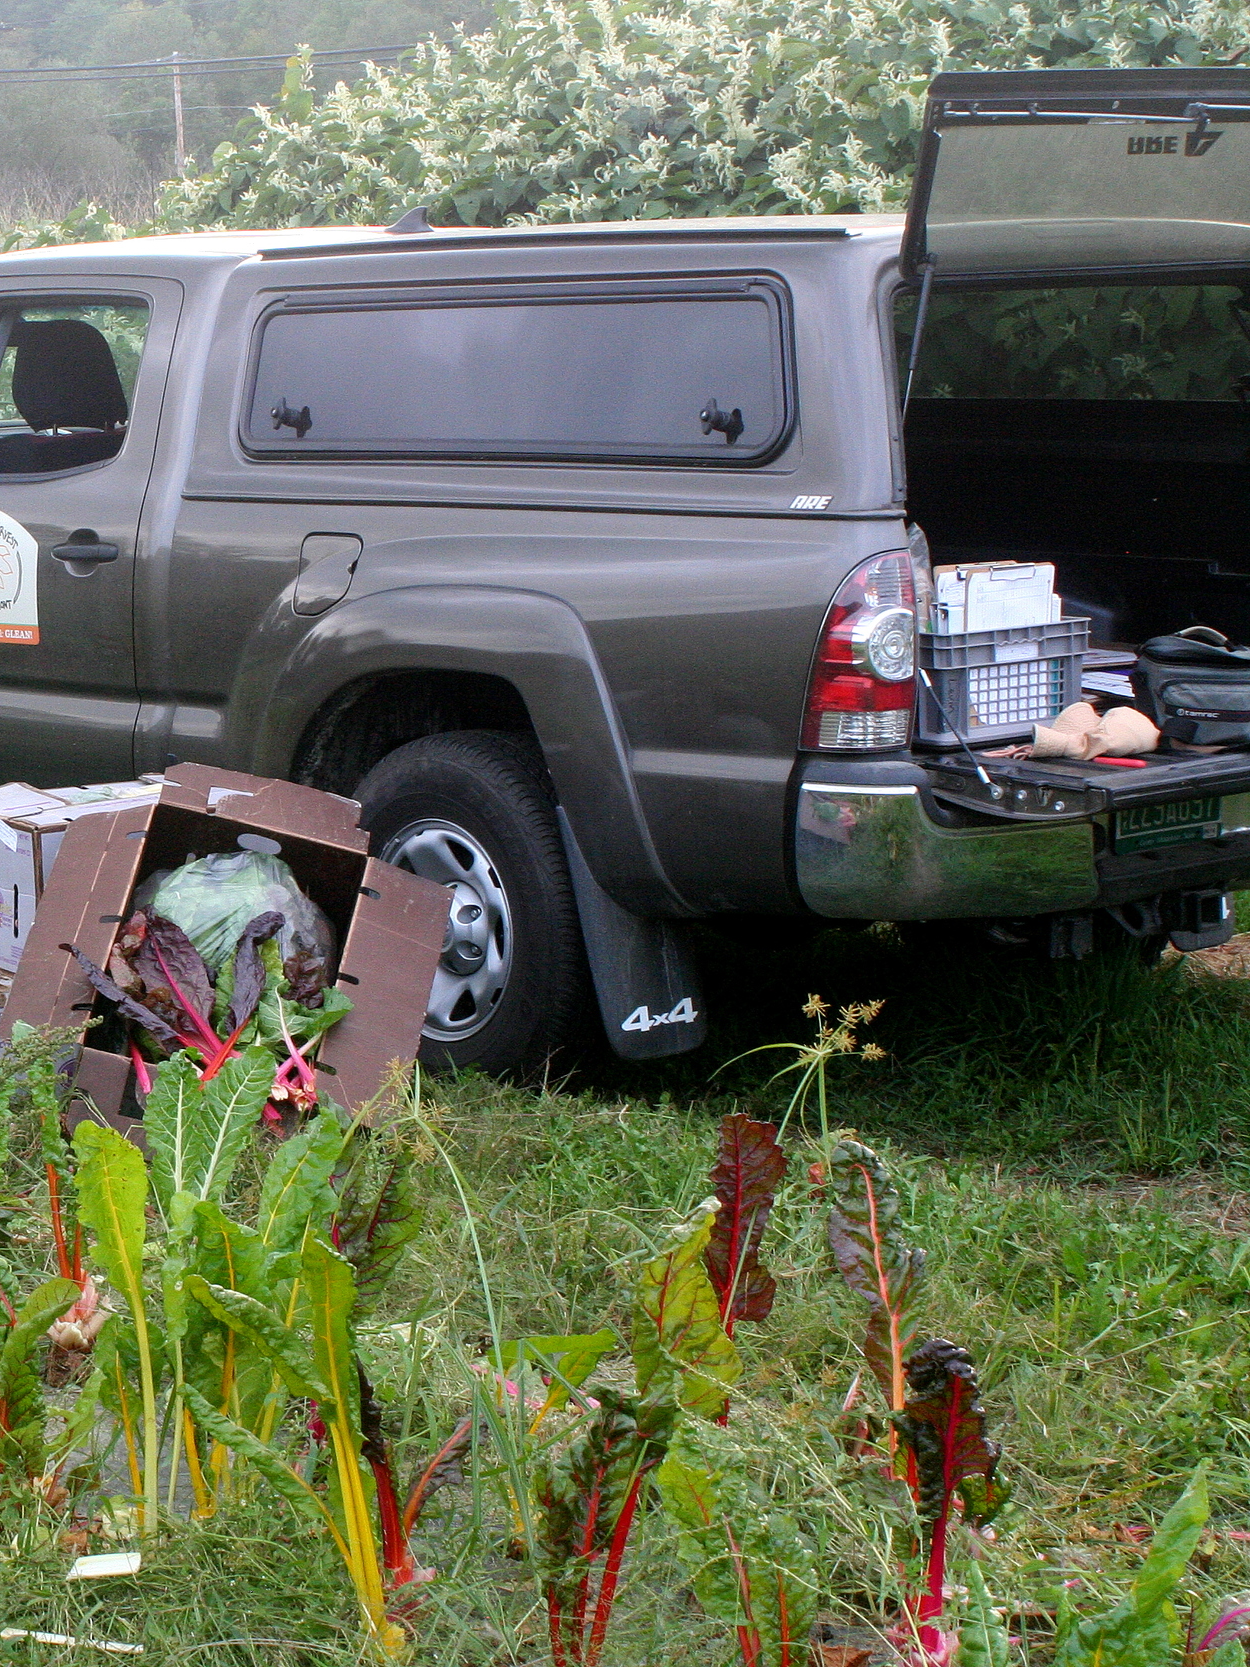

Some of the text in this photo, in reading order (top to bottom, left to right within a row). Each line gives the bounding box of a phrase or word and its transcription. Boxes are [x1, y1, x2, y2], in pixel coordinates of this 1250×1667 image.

[789, 495, 834, 510] ARE
[4, 629, 33, 639] GLEAN!
[621, 997, 699, 1032] 4x4
